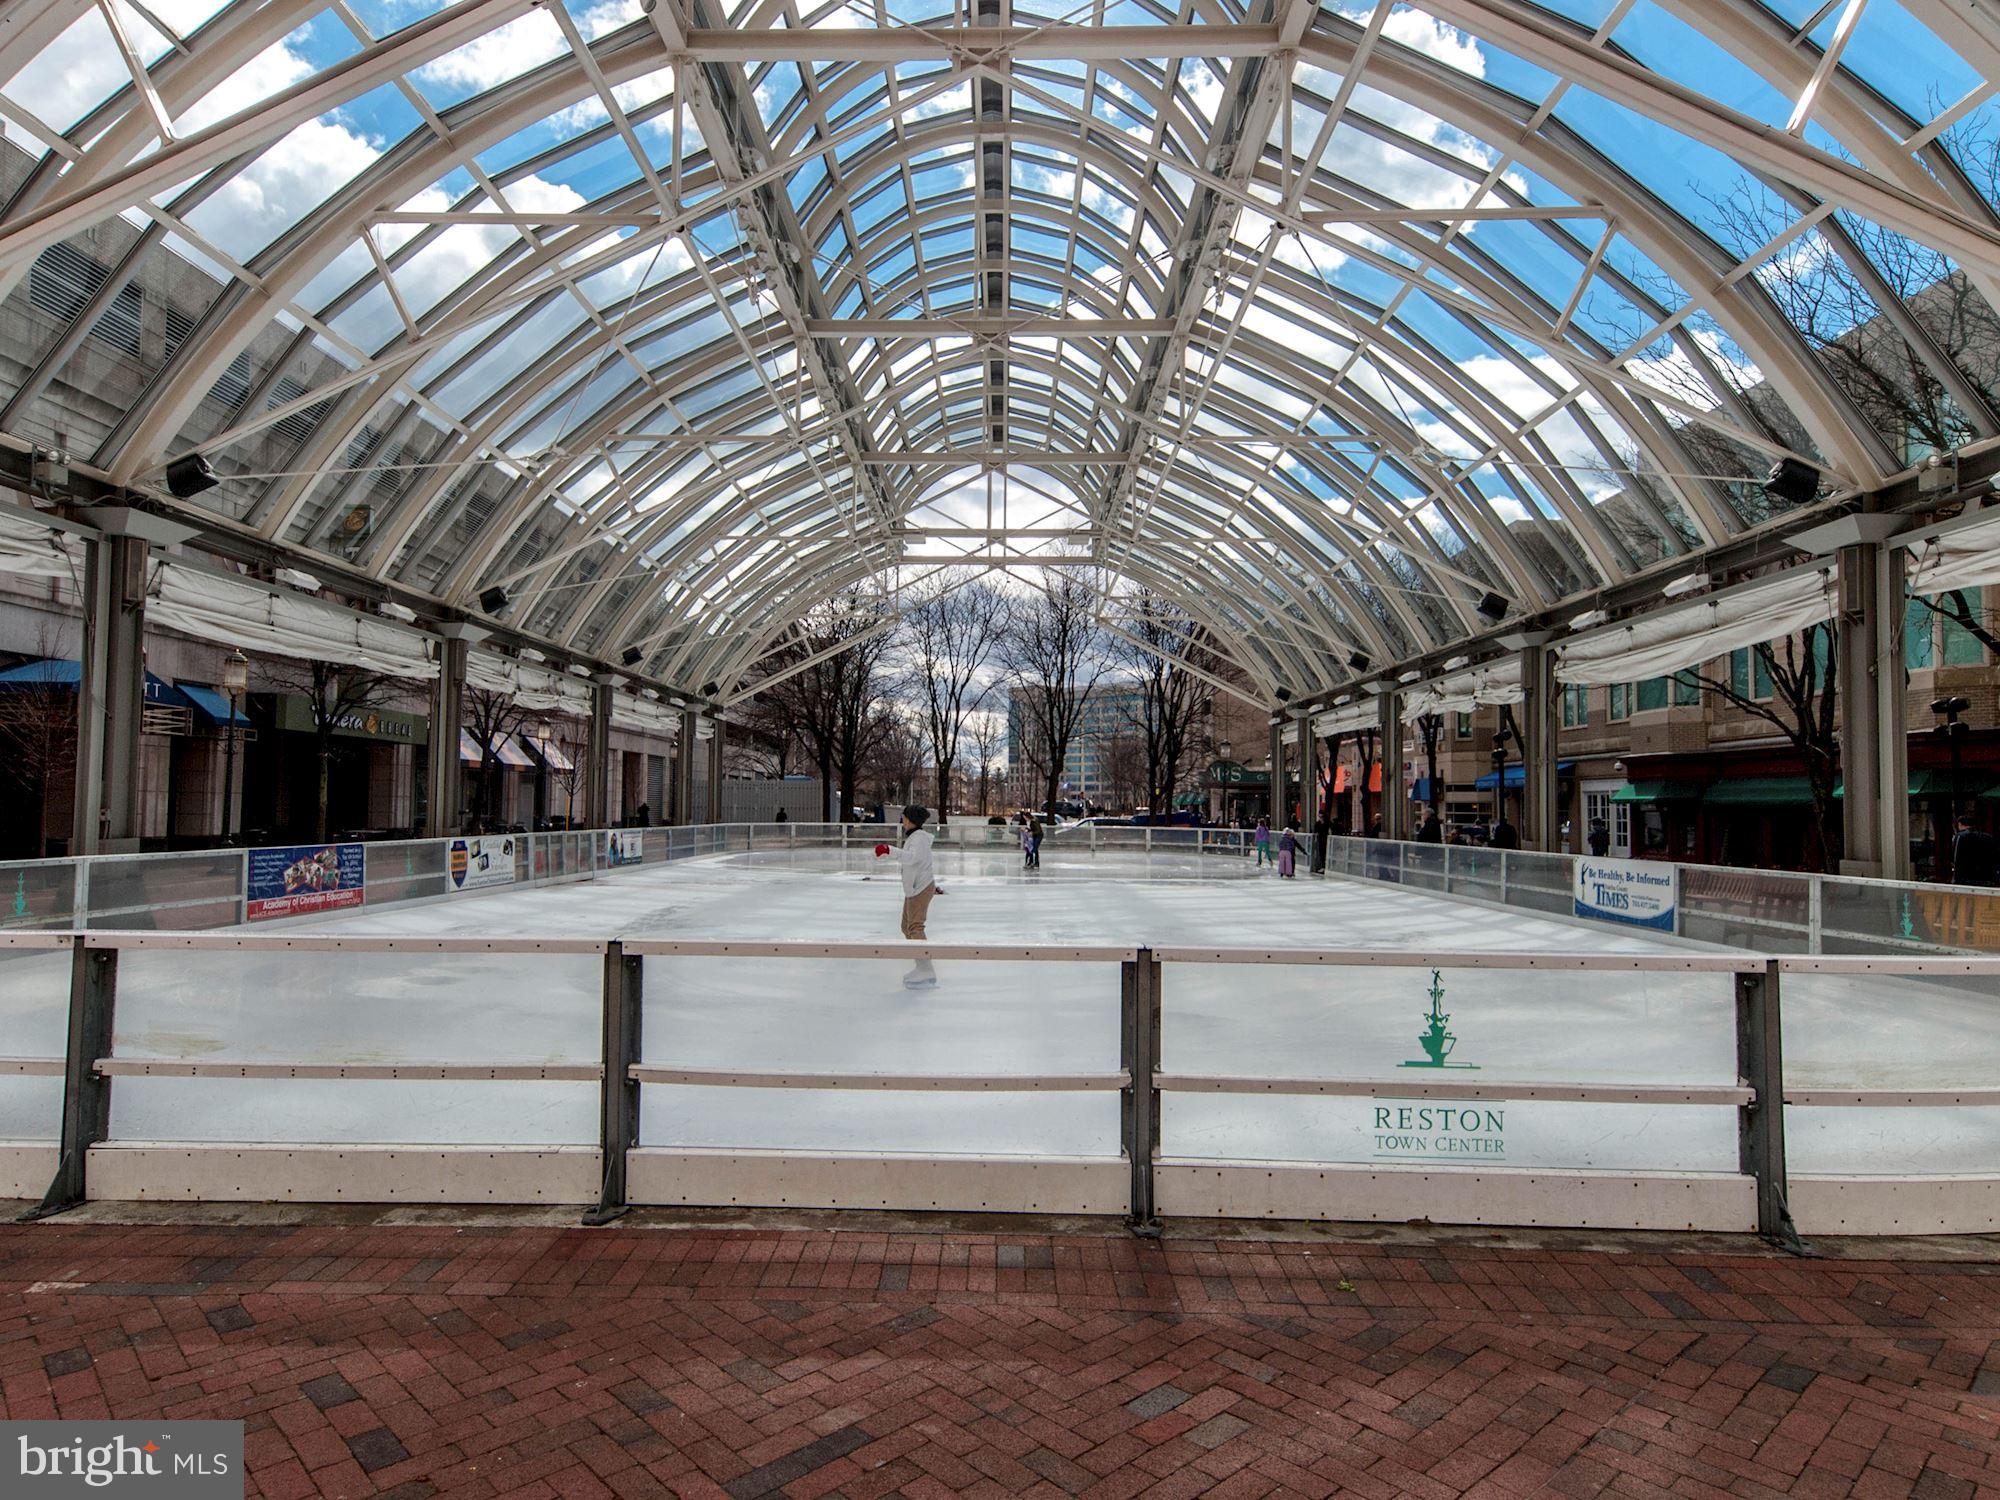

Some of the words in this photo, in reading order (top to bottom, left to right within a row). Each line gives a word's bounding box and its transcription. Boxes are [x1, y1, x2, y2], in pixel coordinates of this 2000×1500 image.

[1589, 869, 1597, 877] Be
[1598, 869, 1624, 884] Healthy,
[1626, 872, 1635, 882] Be
[1636, 872, 1670, 886] Informed
[263, 899, 291, 910] Academy
[300, 894, 325, 905] Christian
[327, 891, 353, 901] Education
[1593, 882, 1629, 910] TIMES
[1374, 1107, 1505, 1132] RESTON
[1375, 1135, 1427, 1151] TOWN
[1435, 1137, 1505, 1153] CENTER
